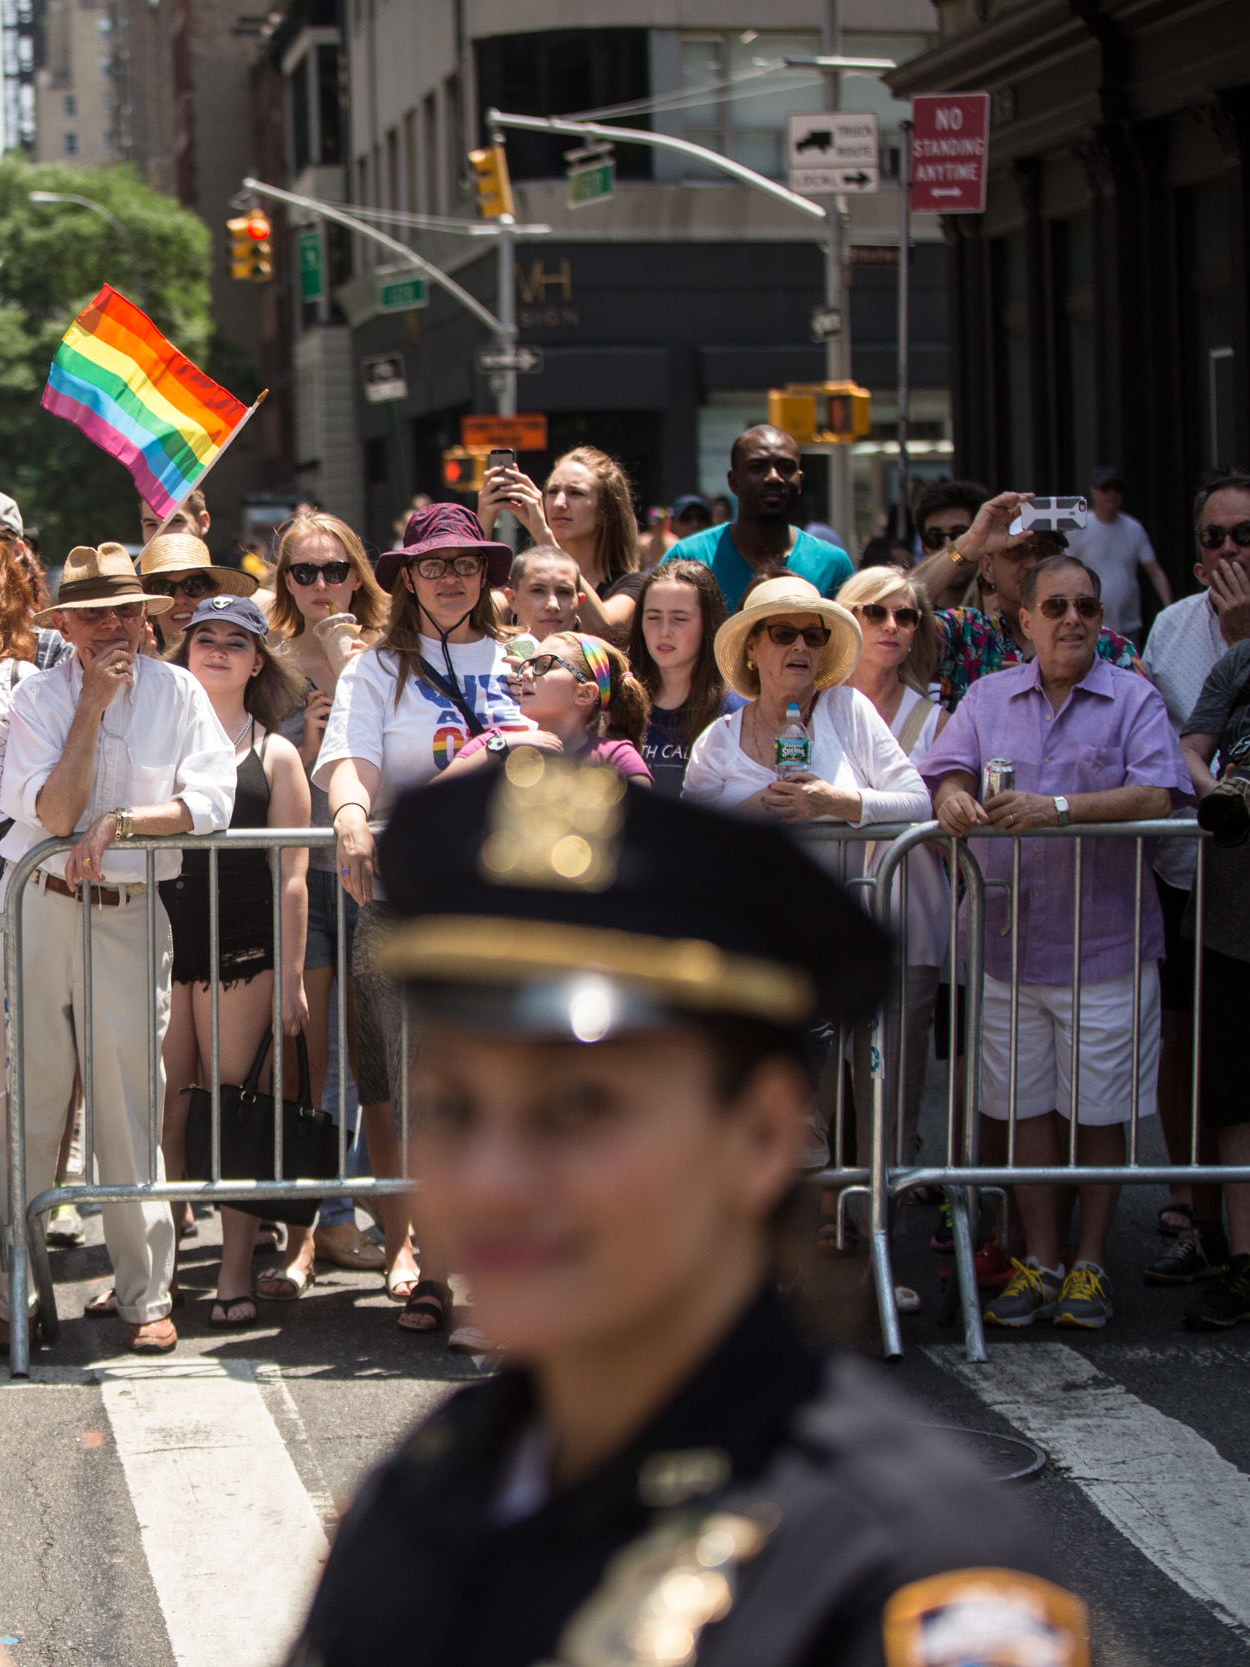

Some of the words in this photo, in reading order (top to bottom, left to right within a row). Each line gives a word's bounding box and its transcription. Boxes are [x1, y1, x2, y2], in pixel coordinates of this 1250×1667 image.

[935, 107, 963, 130] NO
[837, 125, 872, 138] TRUCK
[837, 147, 872, 159] ROUTE
[913, 138, 984, 157] STANDING
[916, 164, 979, 181] ANYTIME
[782, 747, 805, 757] Spring
